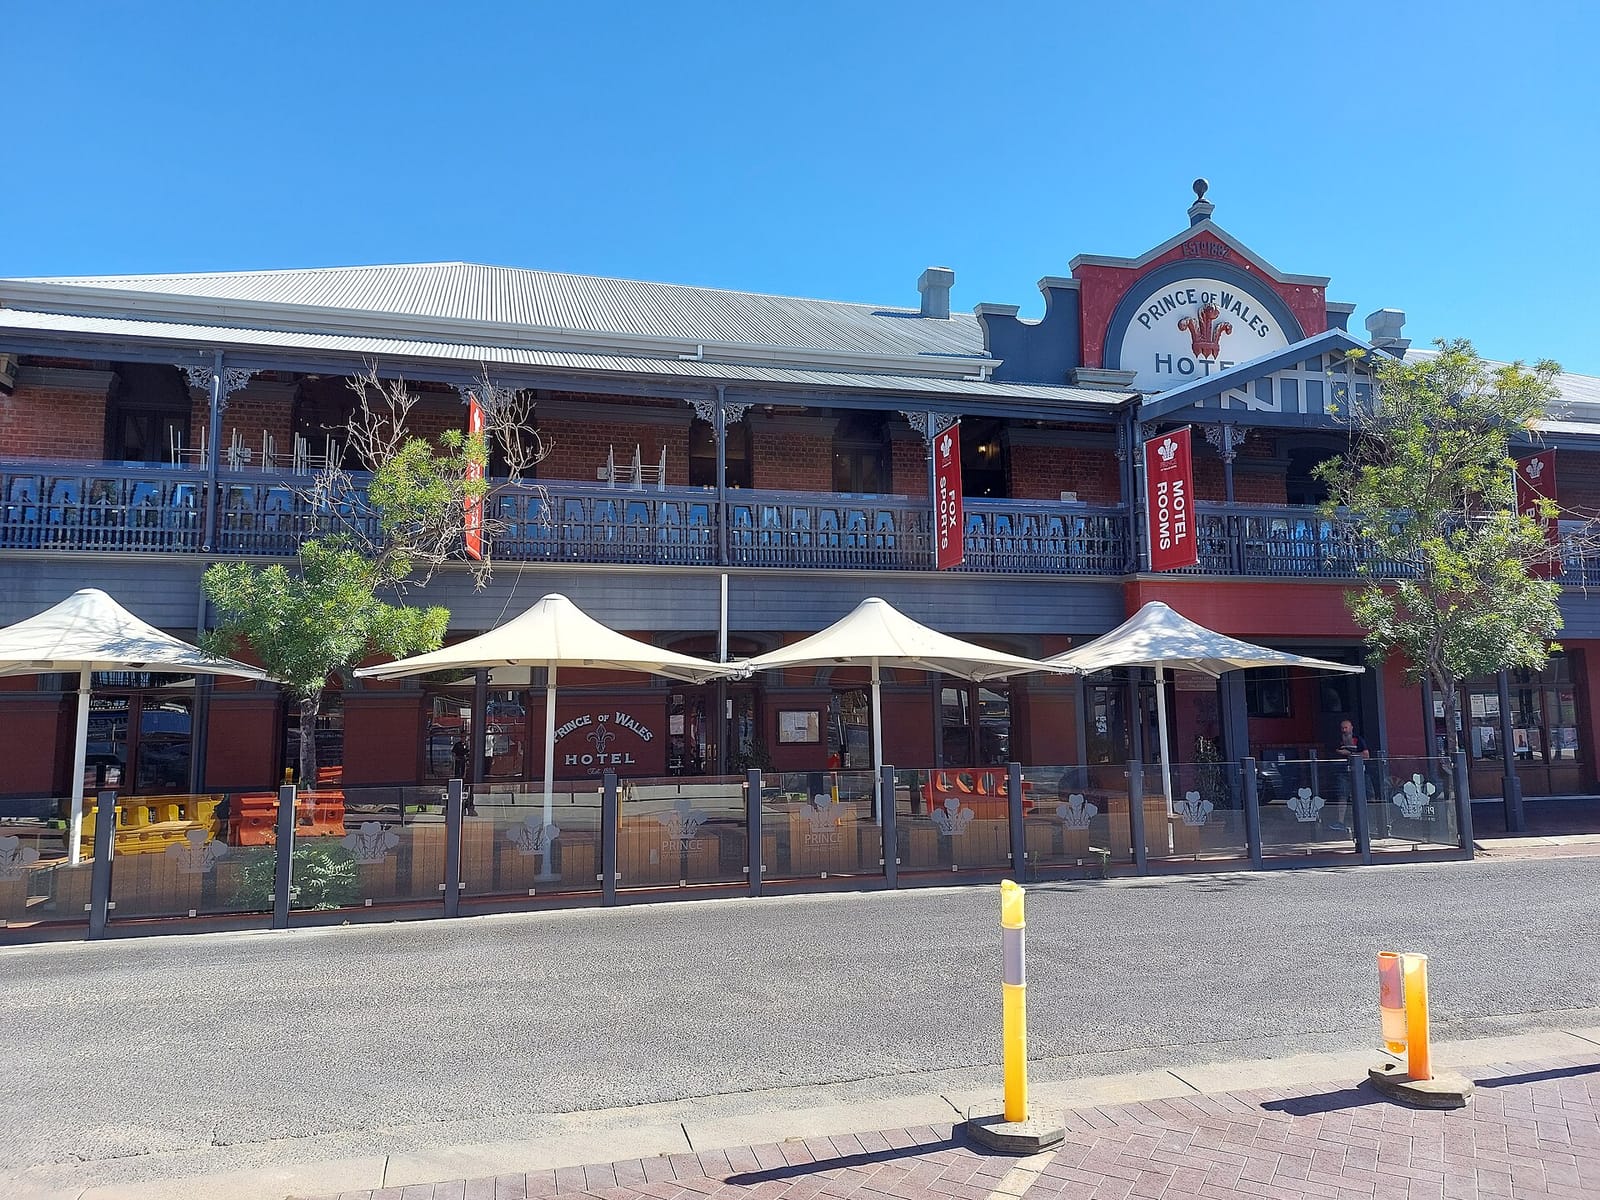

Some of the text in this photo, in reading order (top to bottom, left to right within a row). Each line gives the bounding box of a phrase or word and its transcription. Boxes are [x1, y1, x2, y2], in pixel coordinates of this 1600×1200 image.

[1137, 289, 1270, 338] PRINCE OF WALES
[940, 476, 948, 550] SPORTS
[949, 489, 957, 529] FOX
[1157, 481, 1171, 550] ROOMS
[1172, 480, 1187, 545] MOTEL
[598, 714, 610, 722] OF
[614, 711, 654, 742] WALES
[565, 753, 635, 765] HOTEL
[662, 840, 703, 850] PRINCE
[804, 832, 843, 844] PRINCE
